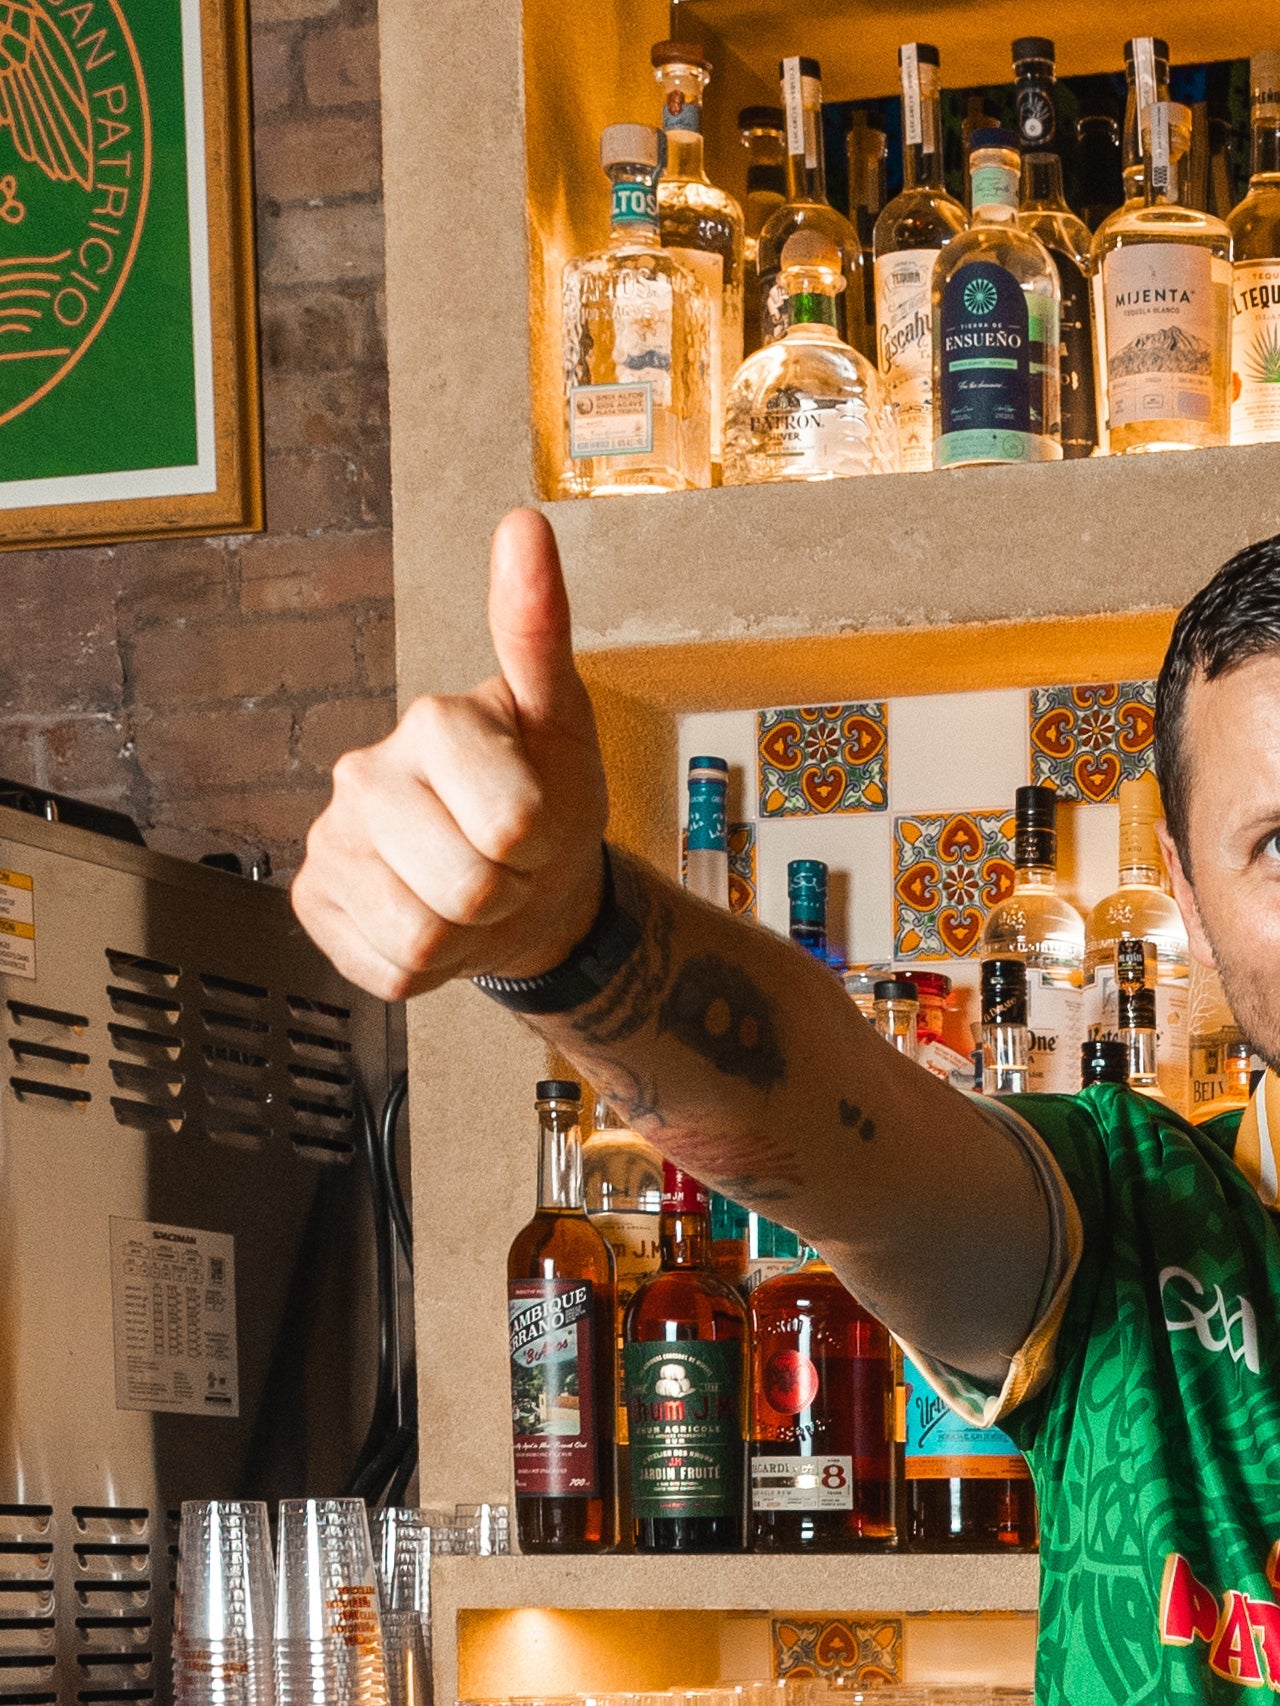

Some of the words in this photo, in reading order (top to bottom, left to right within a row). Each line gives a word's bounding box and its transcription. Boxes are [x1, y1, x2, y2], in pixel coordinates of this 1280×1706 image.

[50, 0, 117, 72] AN
[53, 83, 131, 326] PATRICIO
[1115, 288, 1191, 308] MIJENTA
[1124, 308, 1152, 317] TEQUILA
[1153, 306, 1180, 315] BLANCO
[945, 330, 1022, 352] ENSUEÑO
[639, 1466, 677, 1481] JARDIN
[680, 1464, 721, 1480] FRUITÉ
[821, 1464, 847, 1489] 8
